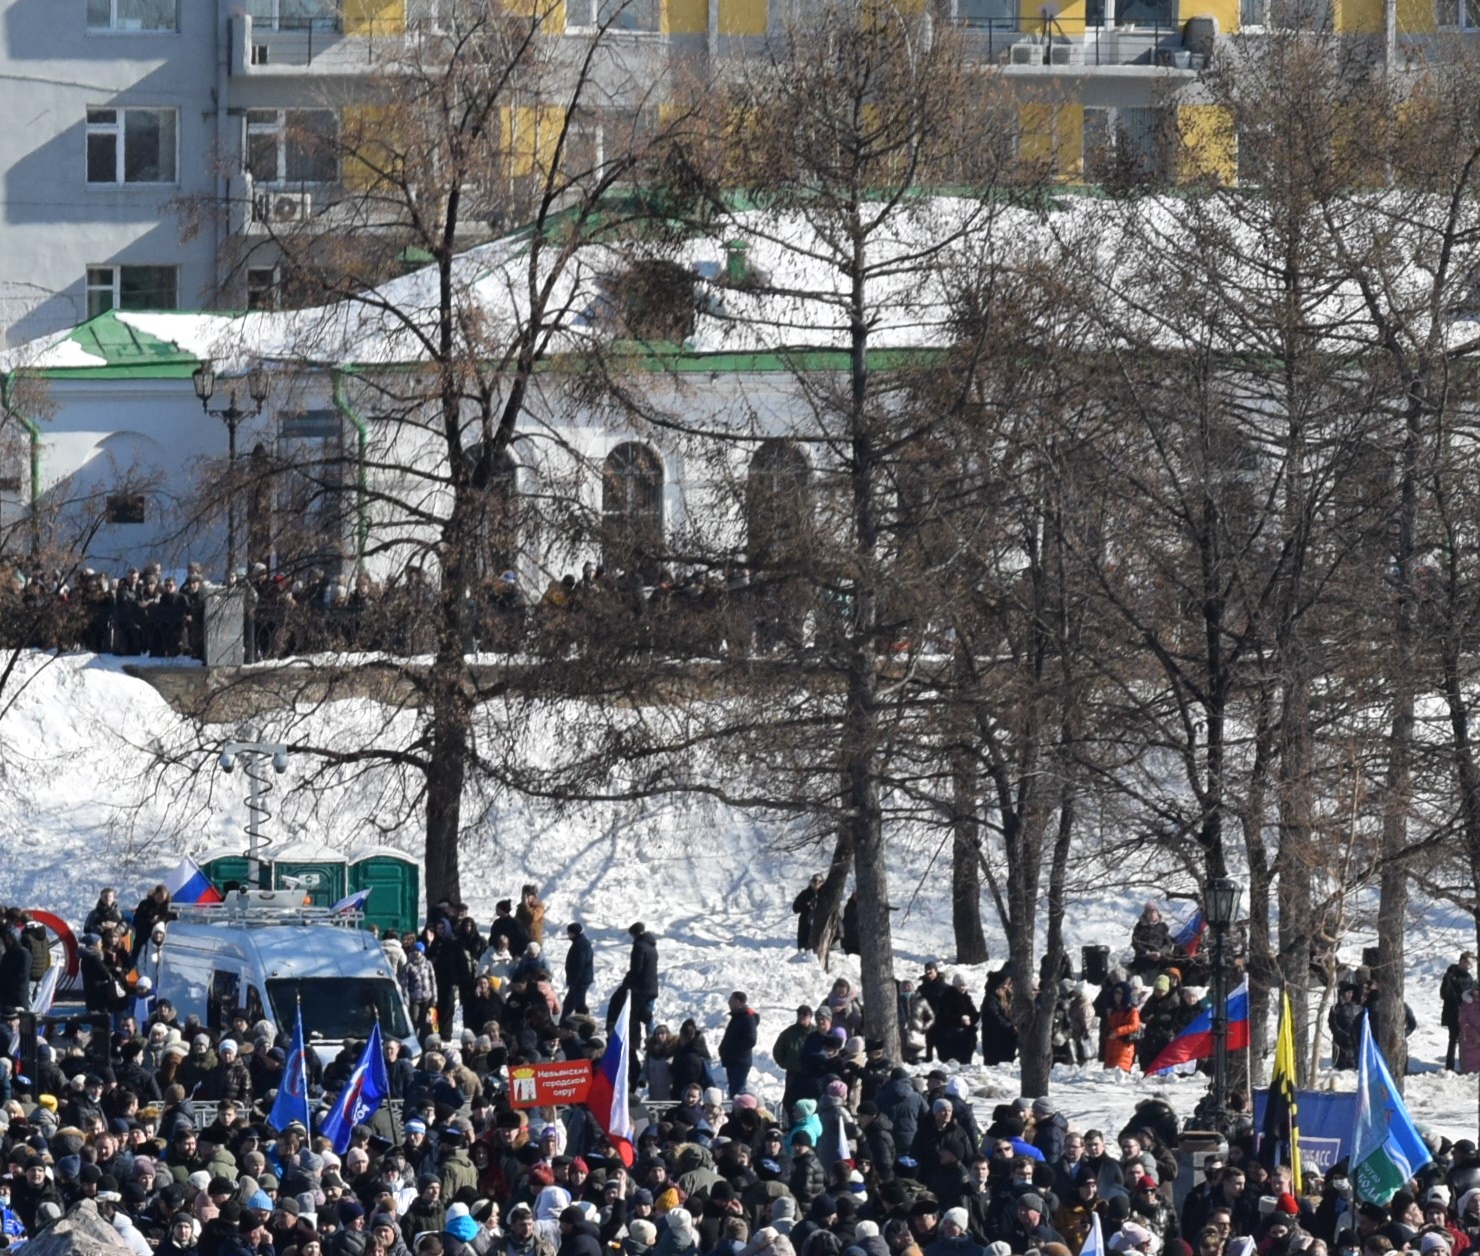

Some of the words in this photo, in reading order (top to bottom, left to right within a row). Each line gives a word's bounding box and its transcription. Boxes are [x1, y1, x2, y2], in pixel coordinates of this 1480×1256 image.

[537, 1067, 589, 1078] Невьянский
[543, 1077, 587, 1088] городской
[553, 1088, 577, 1097] округ
